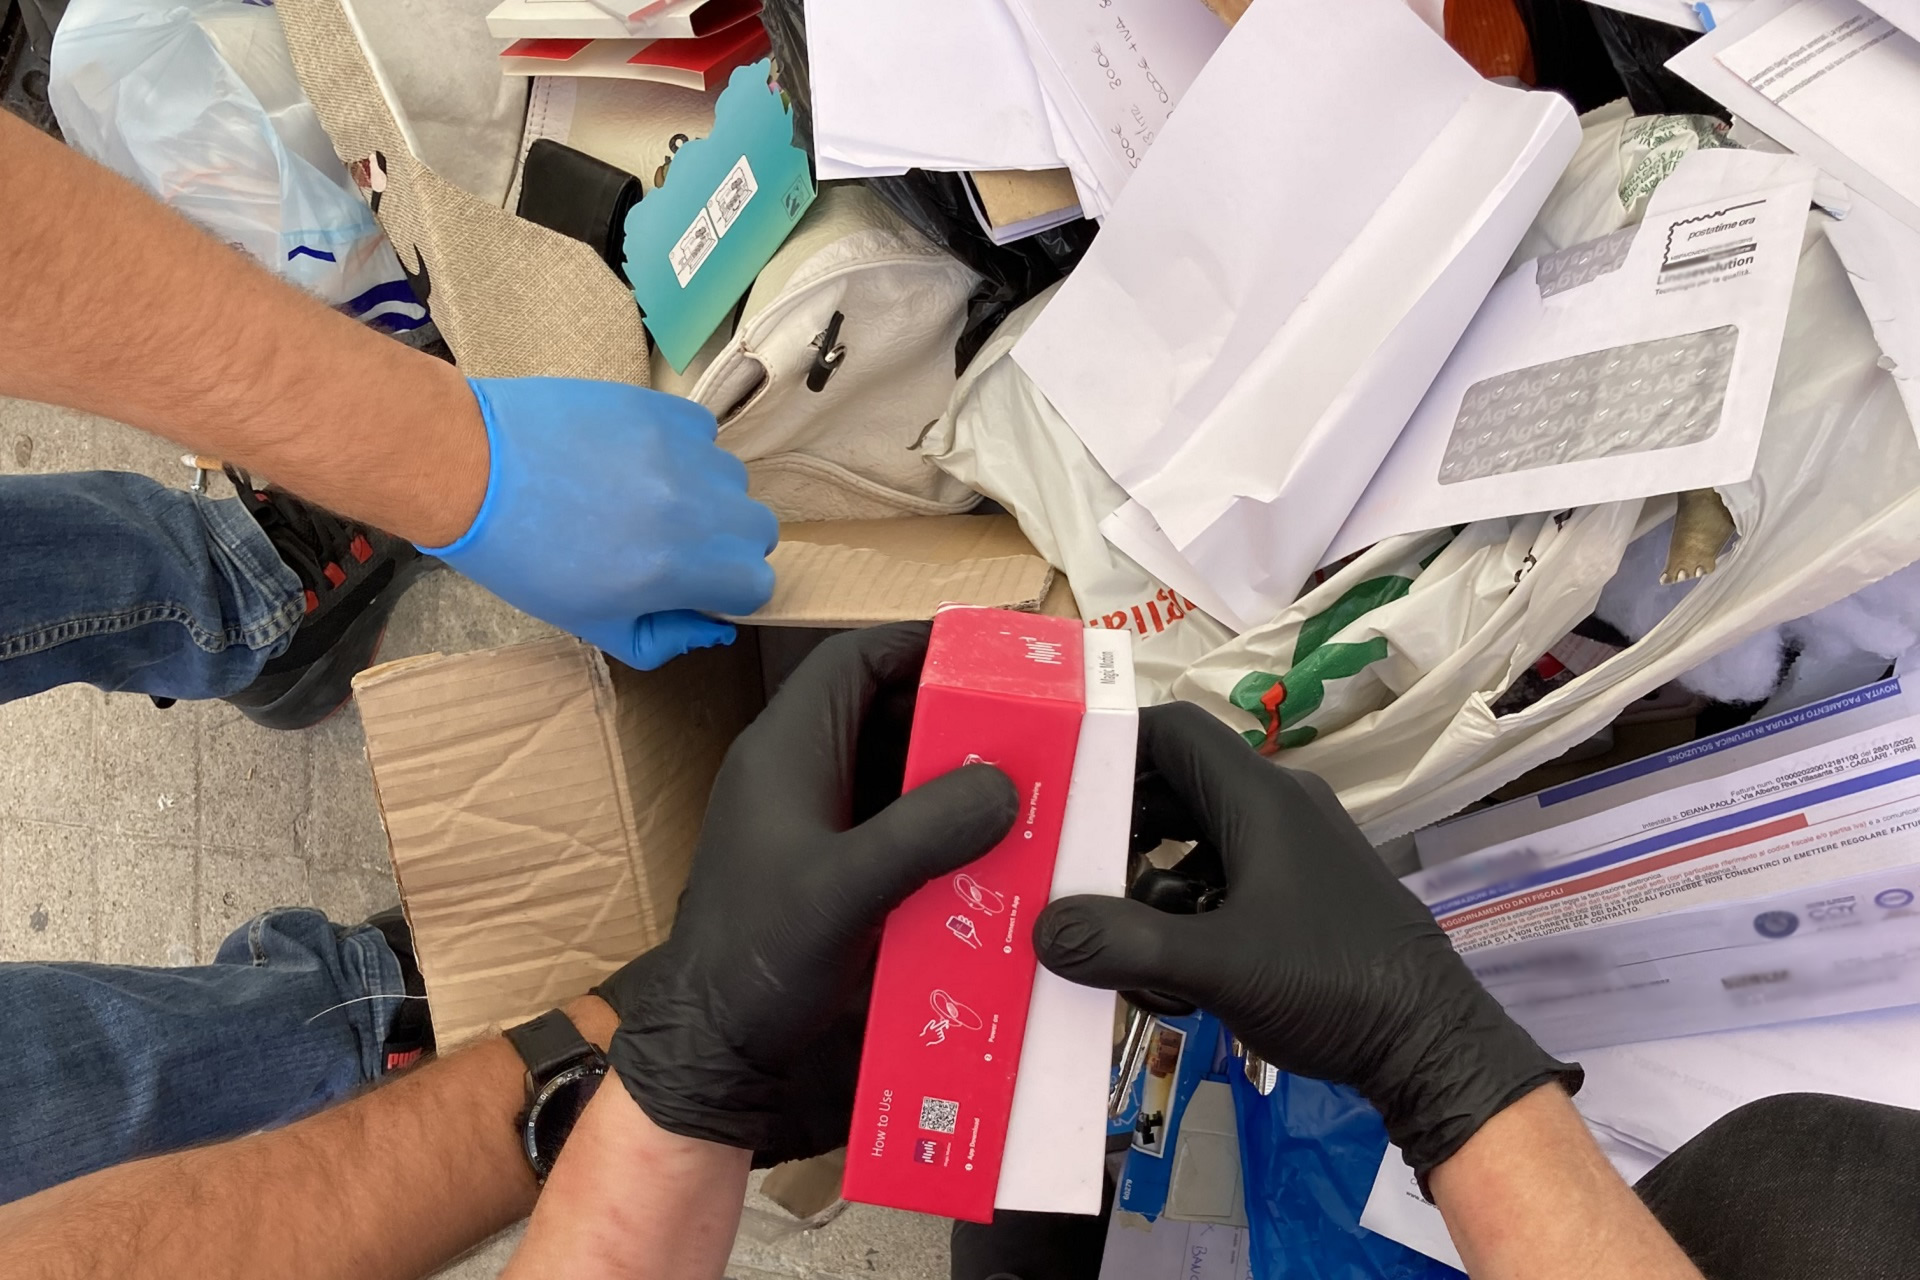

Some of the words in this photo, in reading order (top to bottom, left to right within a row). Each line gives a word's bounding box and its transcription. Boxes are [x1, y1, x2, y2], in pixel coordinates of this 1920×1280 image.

[1685, 220, 1738, 241] postatime
[1737, 216, 1756, 226] ora
[1805, 694, 1861, 718] PAGAMENTO
[1754, 725, 1764, 734] IN
[1764, 712, 1805, 731] FATTURA
[1666, 741, 1713, 763] SOLUZIONE
[1679, 803, 1709, 818] DEIANA
[1709, 796, 1736, 810] PAOLA
[1741, 791, 1754, 800] Via
[1754, 784, 1779, 796] Alberto
[1799, 768, 1833, 783] Villasanta
[1834, 765, 1844, 773] 33
[1849, 751, 1887, 767] CAGLIARI
[1893, 742, 1916, 754] PIRRI
[1730, 784, 1755, 796] Fattura
[1029, 780, 1041, 805] Playing
[1026, 805, 1037, 825] Enjoy
[1502, 933, 1513, 941] LA
[1515, 927, 1532, 937] NON
[1533, 911, 1589, 933] CORRETTEZZA
[1591, 908, 1605, 917] DEI
[1606, 903, 1625, 913] DATI
[1626, 893, 1658, 907] FISCALI
[1659, 880, 1703, 898] POTREBBE
[1705, 874, 1723, 885] NON
[1725, 858, 1781, 880] CONSENTIRCI
[1793, 842, 1838, 860] EMETTERE
[1840, 828, 1888, 848] REGOLARE
[1004, 916, 1016, 943] Connect
[1011, 894, 1020, 909] App
[1440, 902, 1511, 929] AGGIORNAMENTO
[1512, 896, 1531, 907] DATI
[1532, 887, 1564, 902] FISCALI
[1489, 916, 1506, 926] 2019
[1573, 919, 1589, 928] DEL
[1452, 938, 1478, 950] ventuali
[987, 1023, 997, 1042] Power
[992, 1013, 999, 1022] on
[878, 1088, 894, 1112] Use
[876, 1113, 889, 1128] to
[968, 1116, 980, 1147] Download
[870, 1129, 887, 1157] How
[967, 1147, 975, 1160] App
